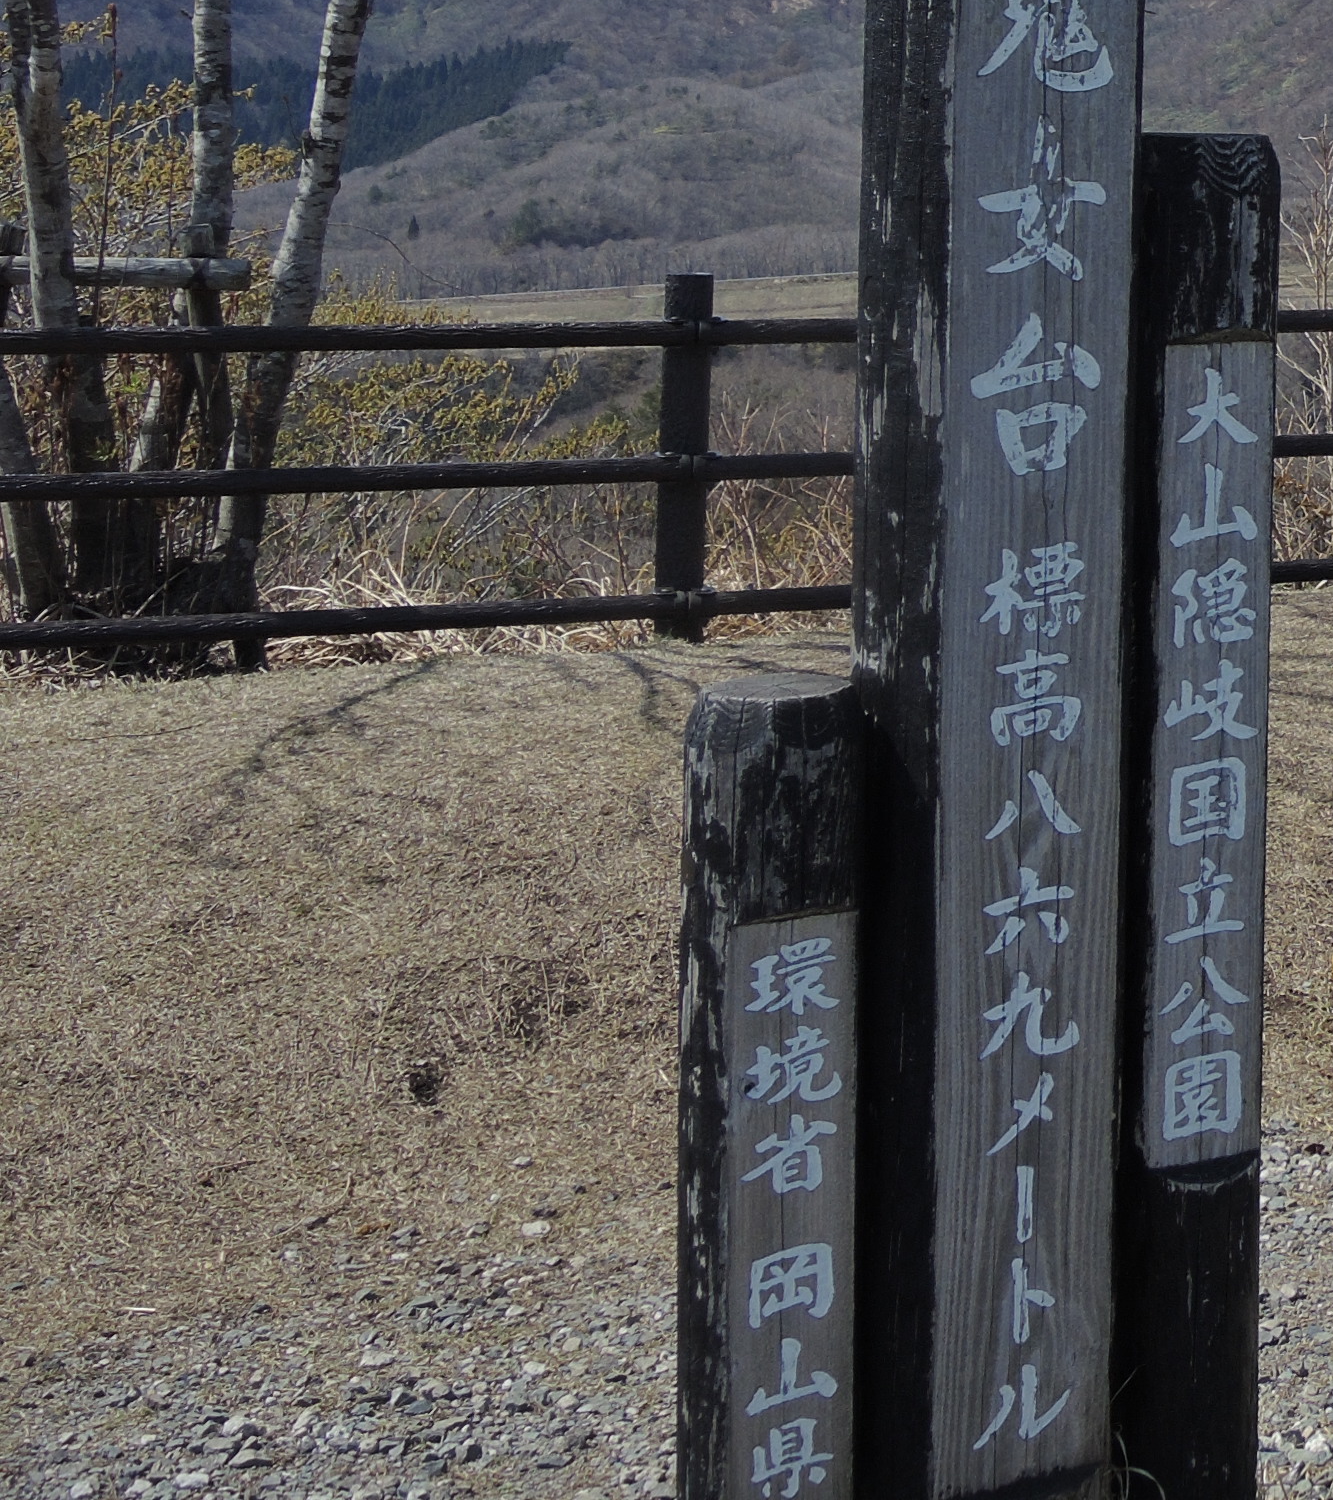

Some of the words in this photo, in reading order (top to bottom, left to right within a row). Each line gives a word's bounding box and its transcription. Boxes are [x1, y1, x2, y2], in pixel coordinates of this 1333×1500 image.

[1159, 367, 1259, 1141] 大山隠岐国立公園
